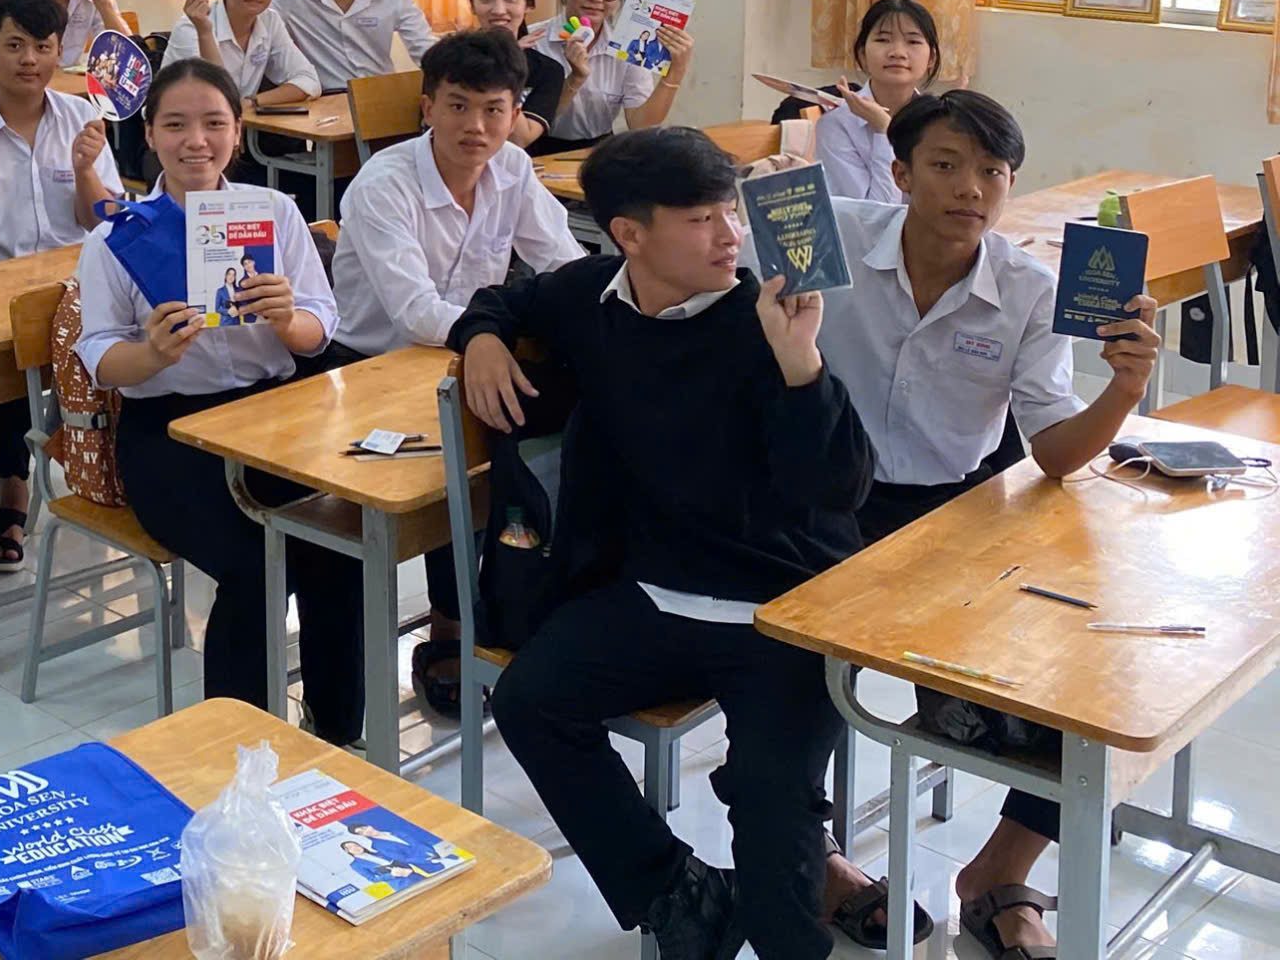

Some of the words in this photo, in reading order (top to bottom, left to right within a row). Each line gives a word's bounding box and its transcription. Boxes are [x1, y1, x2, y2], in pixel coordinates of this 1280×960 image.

[28, 790, 66, 806] SEN
[2, 830, 67, 855] World
[69, 822, 116, 836] Class
[16, 830, 126, 864] EDUCATION
